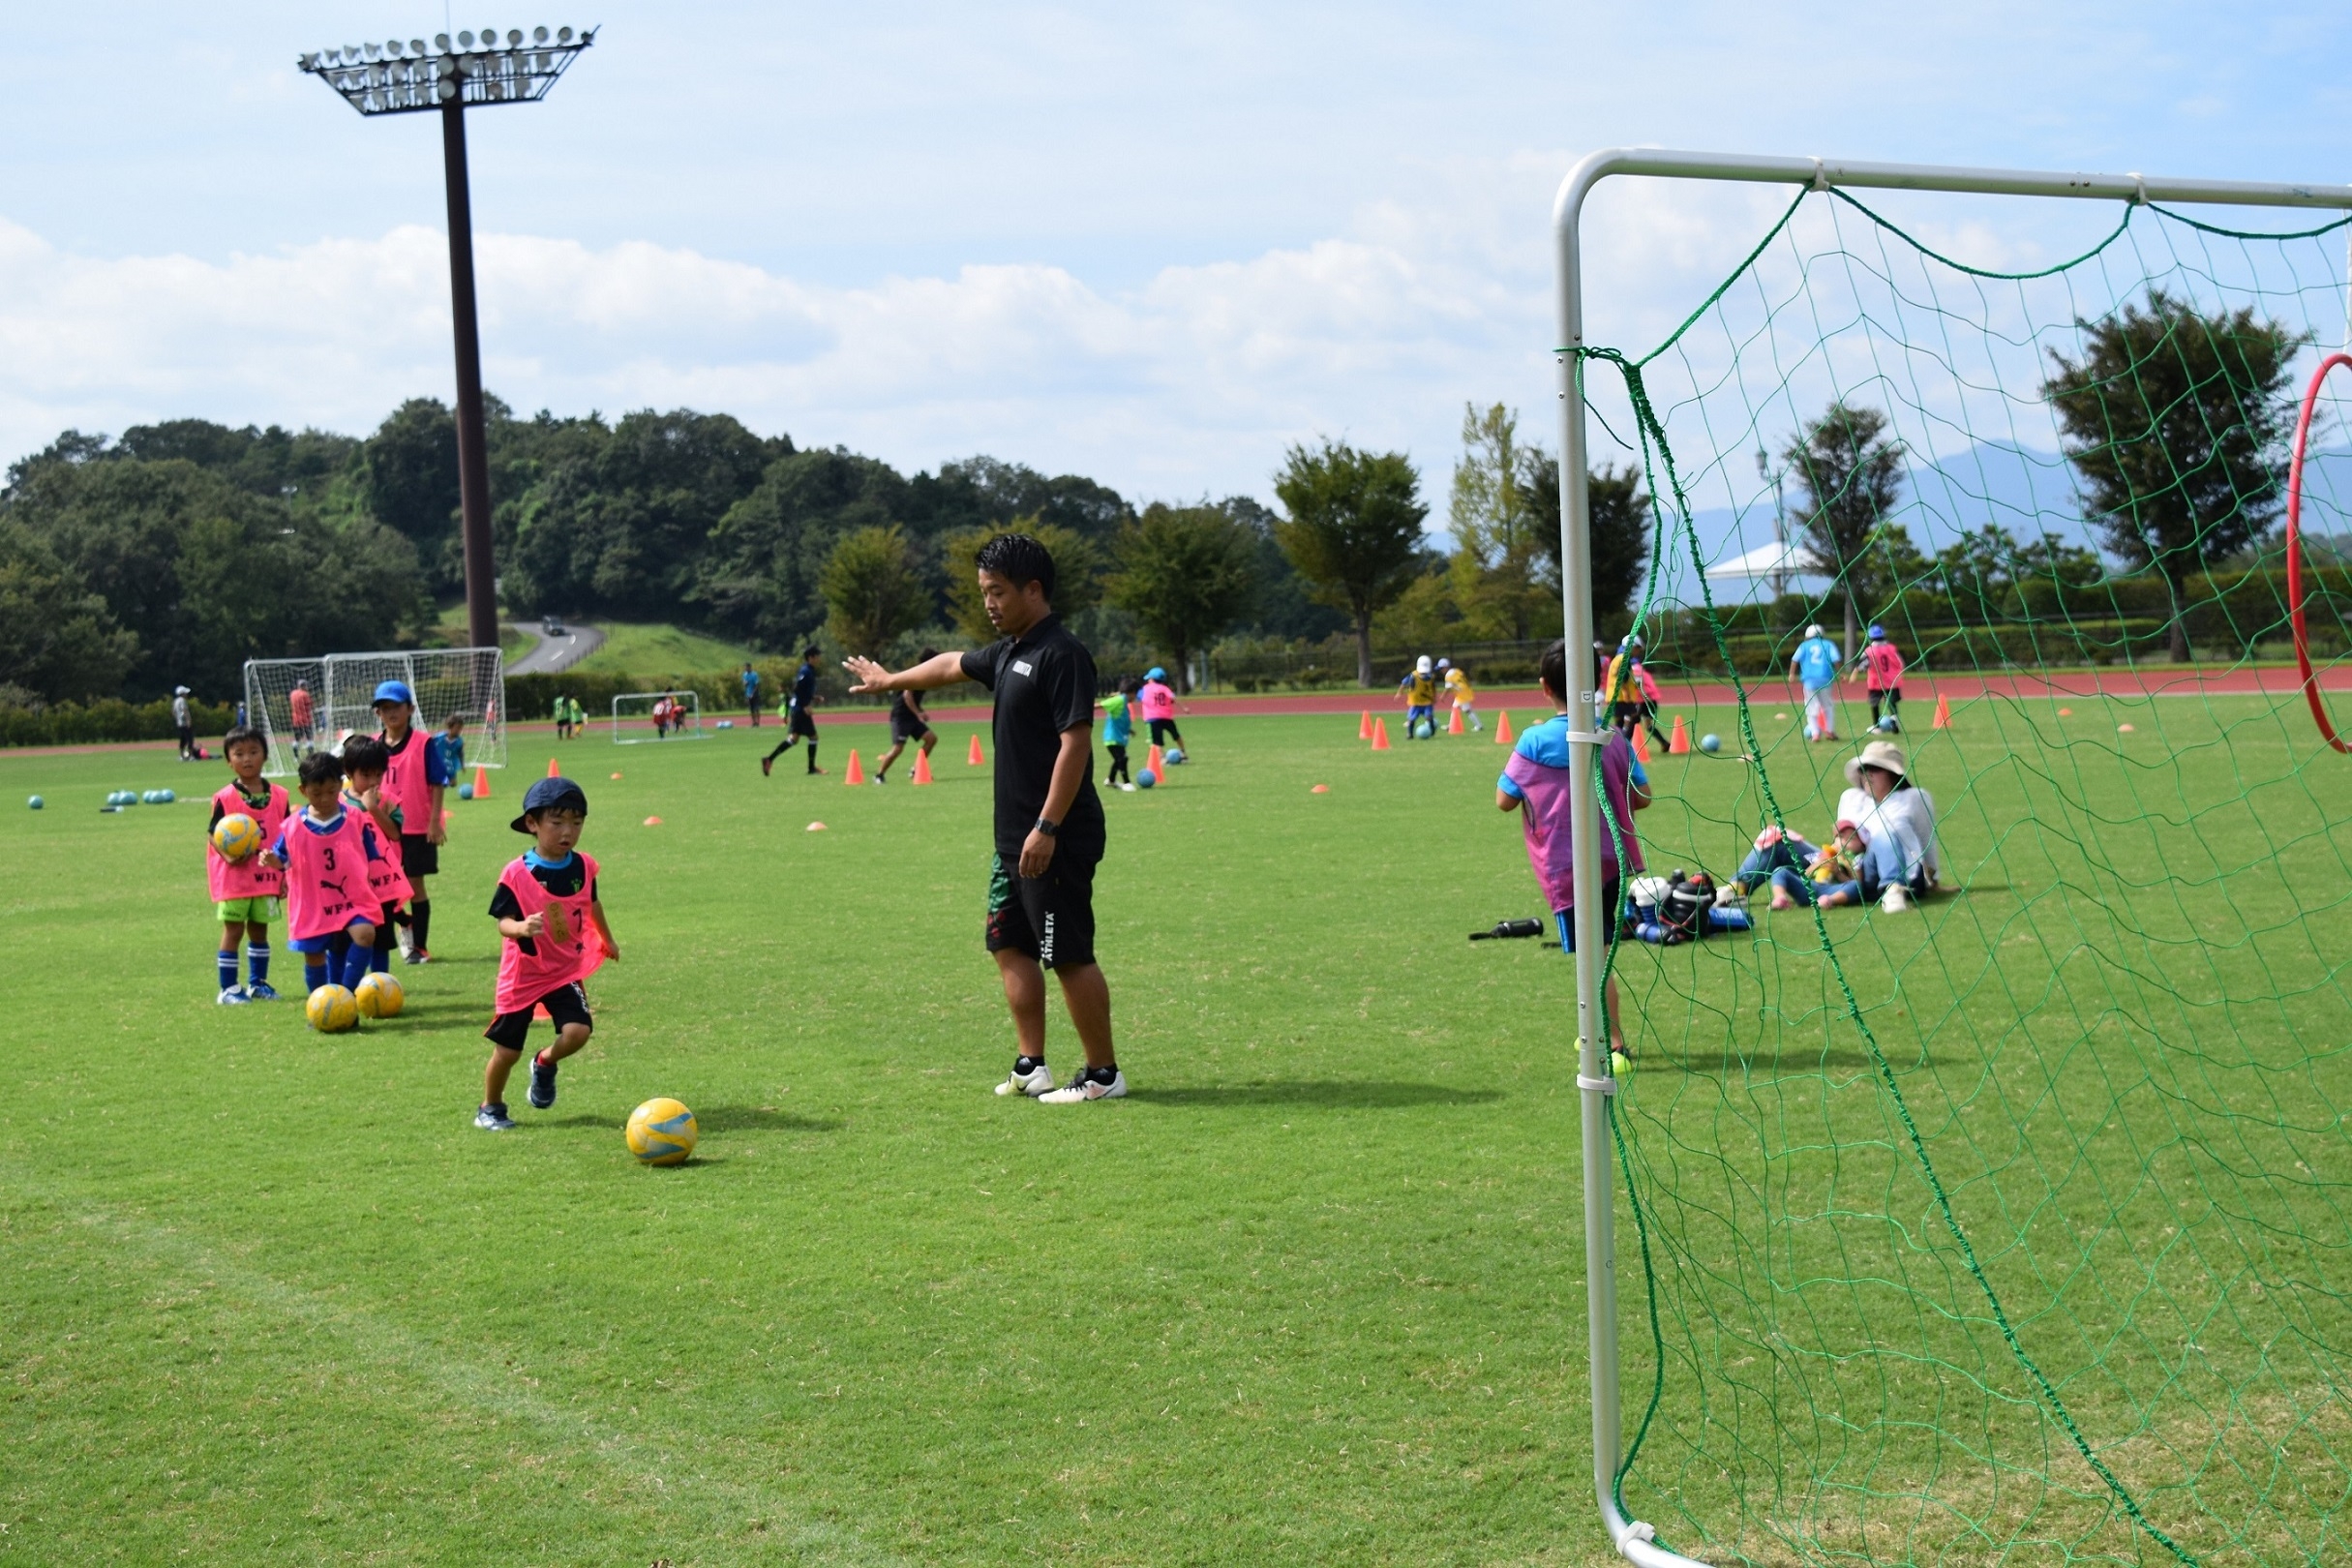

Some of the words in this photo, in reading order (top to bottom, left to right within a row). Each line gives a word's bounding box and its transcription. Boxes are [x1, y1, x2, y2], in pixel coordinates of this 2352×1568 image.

[1810, 645, 1822, 664] 2
[1880, 654, 1889, 672] 9
[1154, 692, 1166, 707] 10
[386, 767, 397, 785] 11
[323, 848, 336, 871] 3
[254, 872, 278, 884] WFA
[370, 872, 402, 889] WFA
[323, 901, 355, 917] WFA
[572, 908, 583, 933] 7
[1043, 912, 1055, 962] ATHLETA
[1605, 1259, 1613, 1269] C
